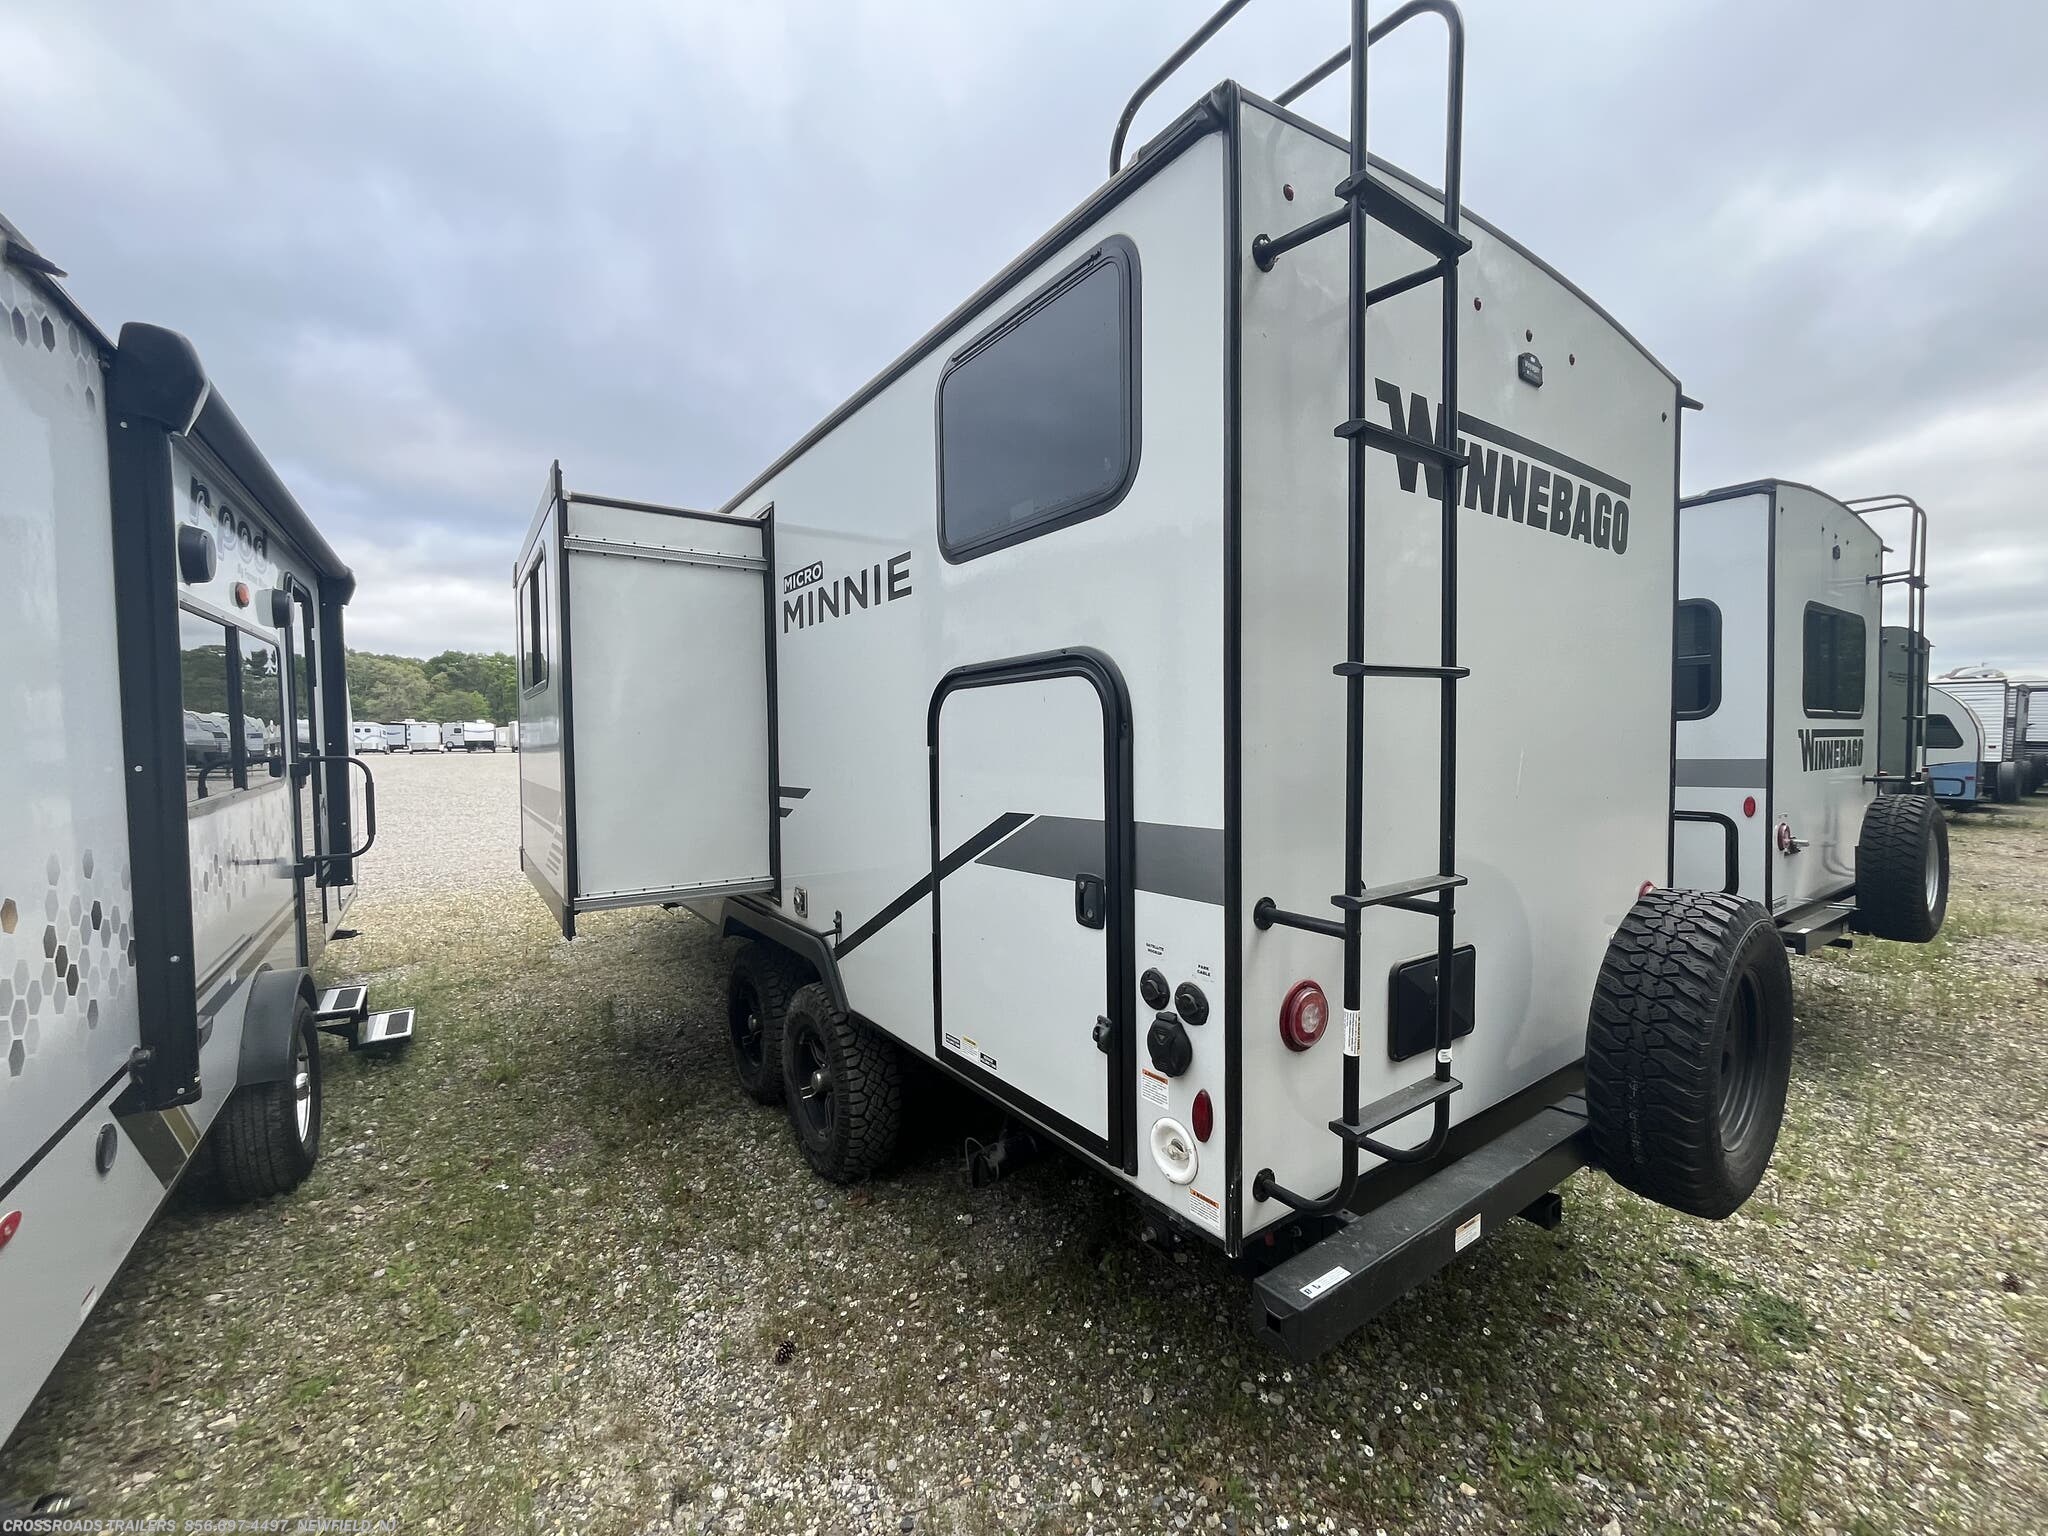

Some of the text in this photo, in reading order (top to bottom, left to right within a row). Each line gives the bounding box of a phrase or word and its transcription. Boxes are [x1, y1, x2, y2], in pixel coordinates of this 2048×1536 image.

[783, 562, 824, 594] MICRO
[783, 550, 913, 634] MINNIE
[1798, 729, 1864, 773] WINNEBAGO
